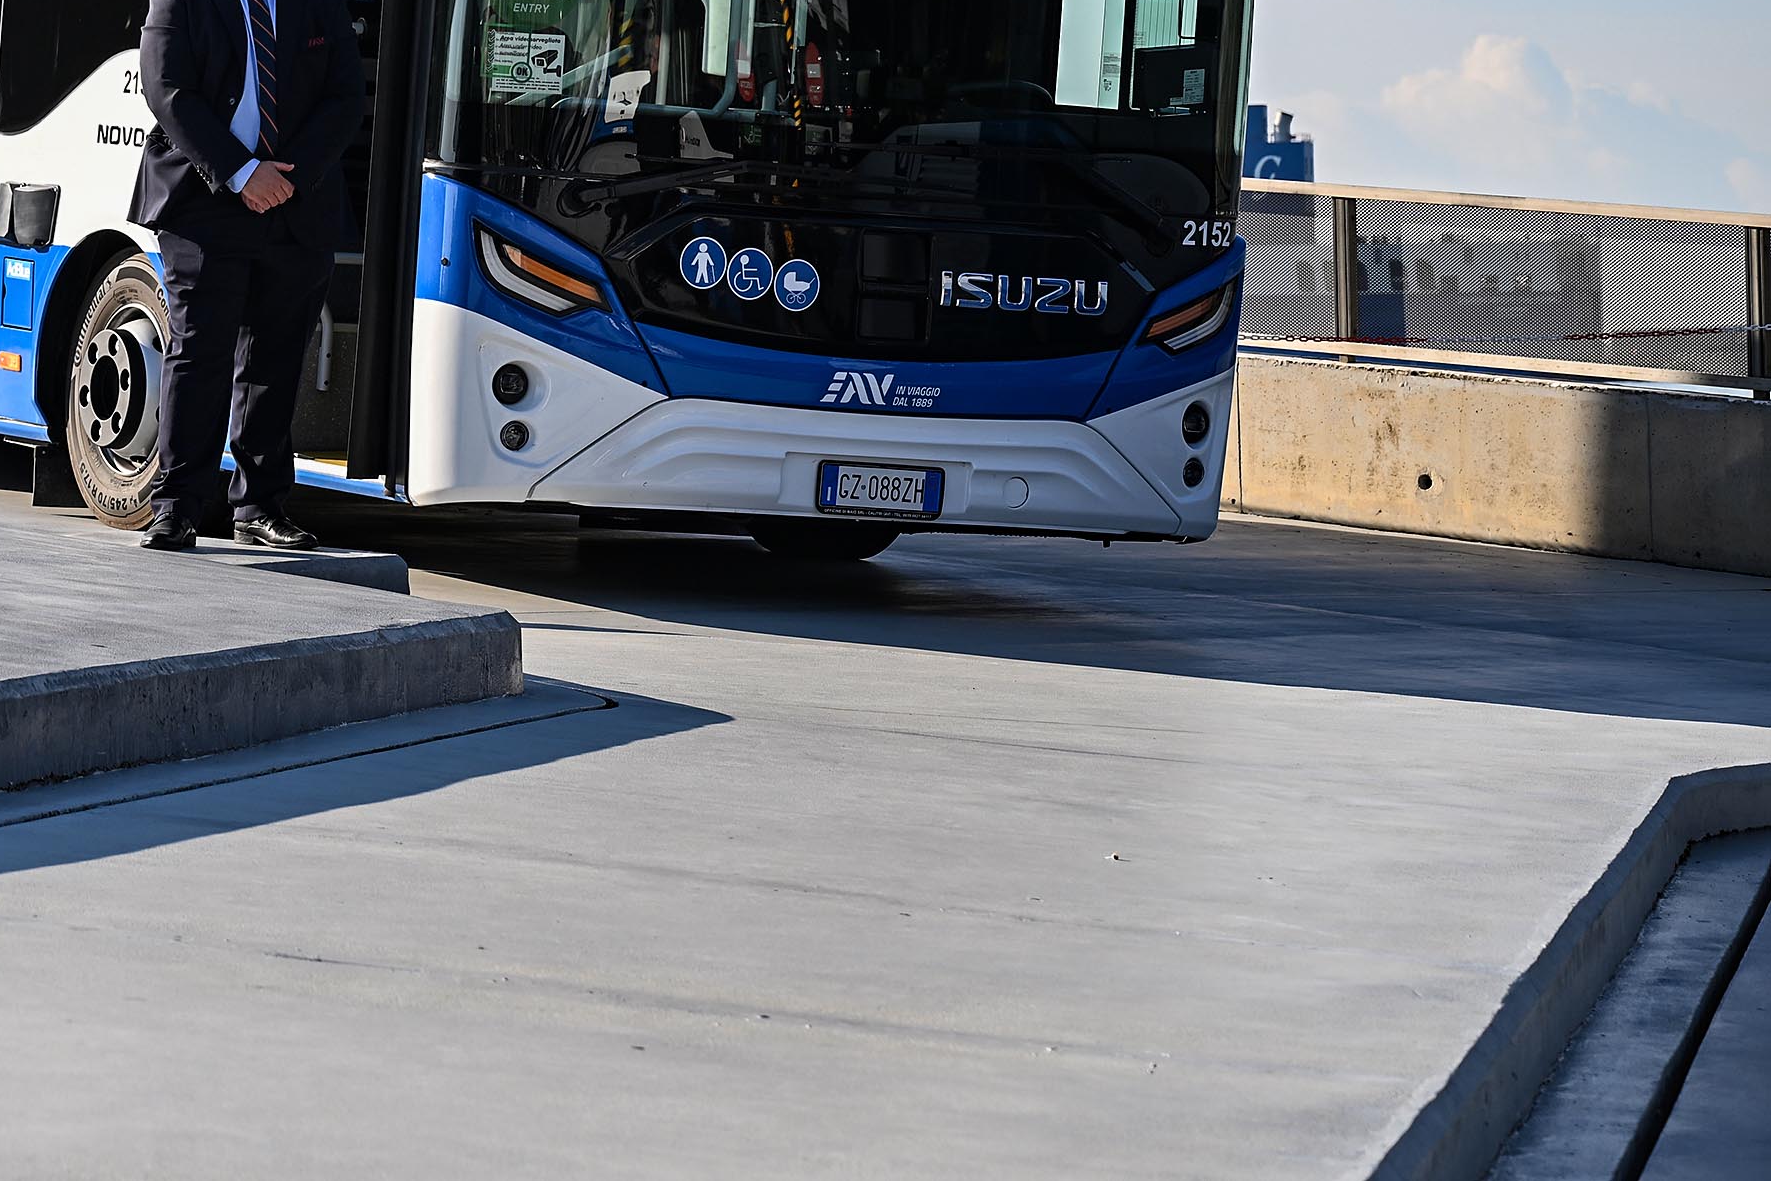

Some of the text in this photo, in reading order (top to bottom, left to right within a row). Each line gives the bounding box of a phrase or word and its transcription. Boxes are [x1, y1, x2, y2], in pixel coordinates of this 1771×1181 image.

[513, 2, 550, 14] ENTRY
[516, 66, 528, 76] OK
[123, 69, 143, 94] 21
[96, 123, 149, 147] NOVO
[1182, 220, 1231, 247] 2152
[939, 270, 1108, 316] ISUZU
[895, 385, 941, 397] IN VIAGGIO
[892, 396, 933, 408] DAL 1889
